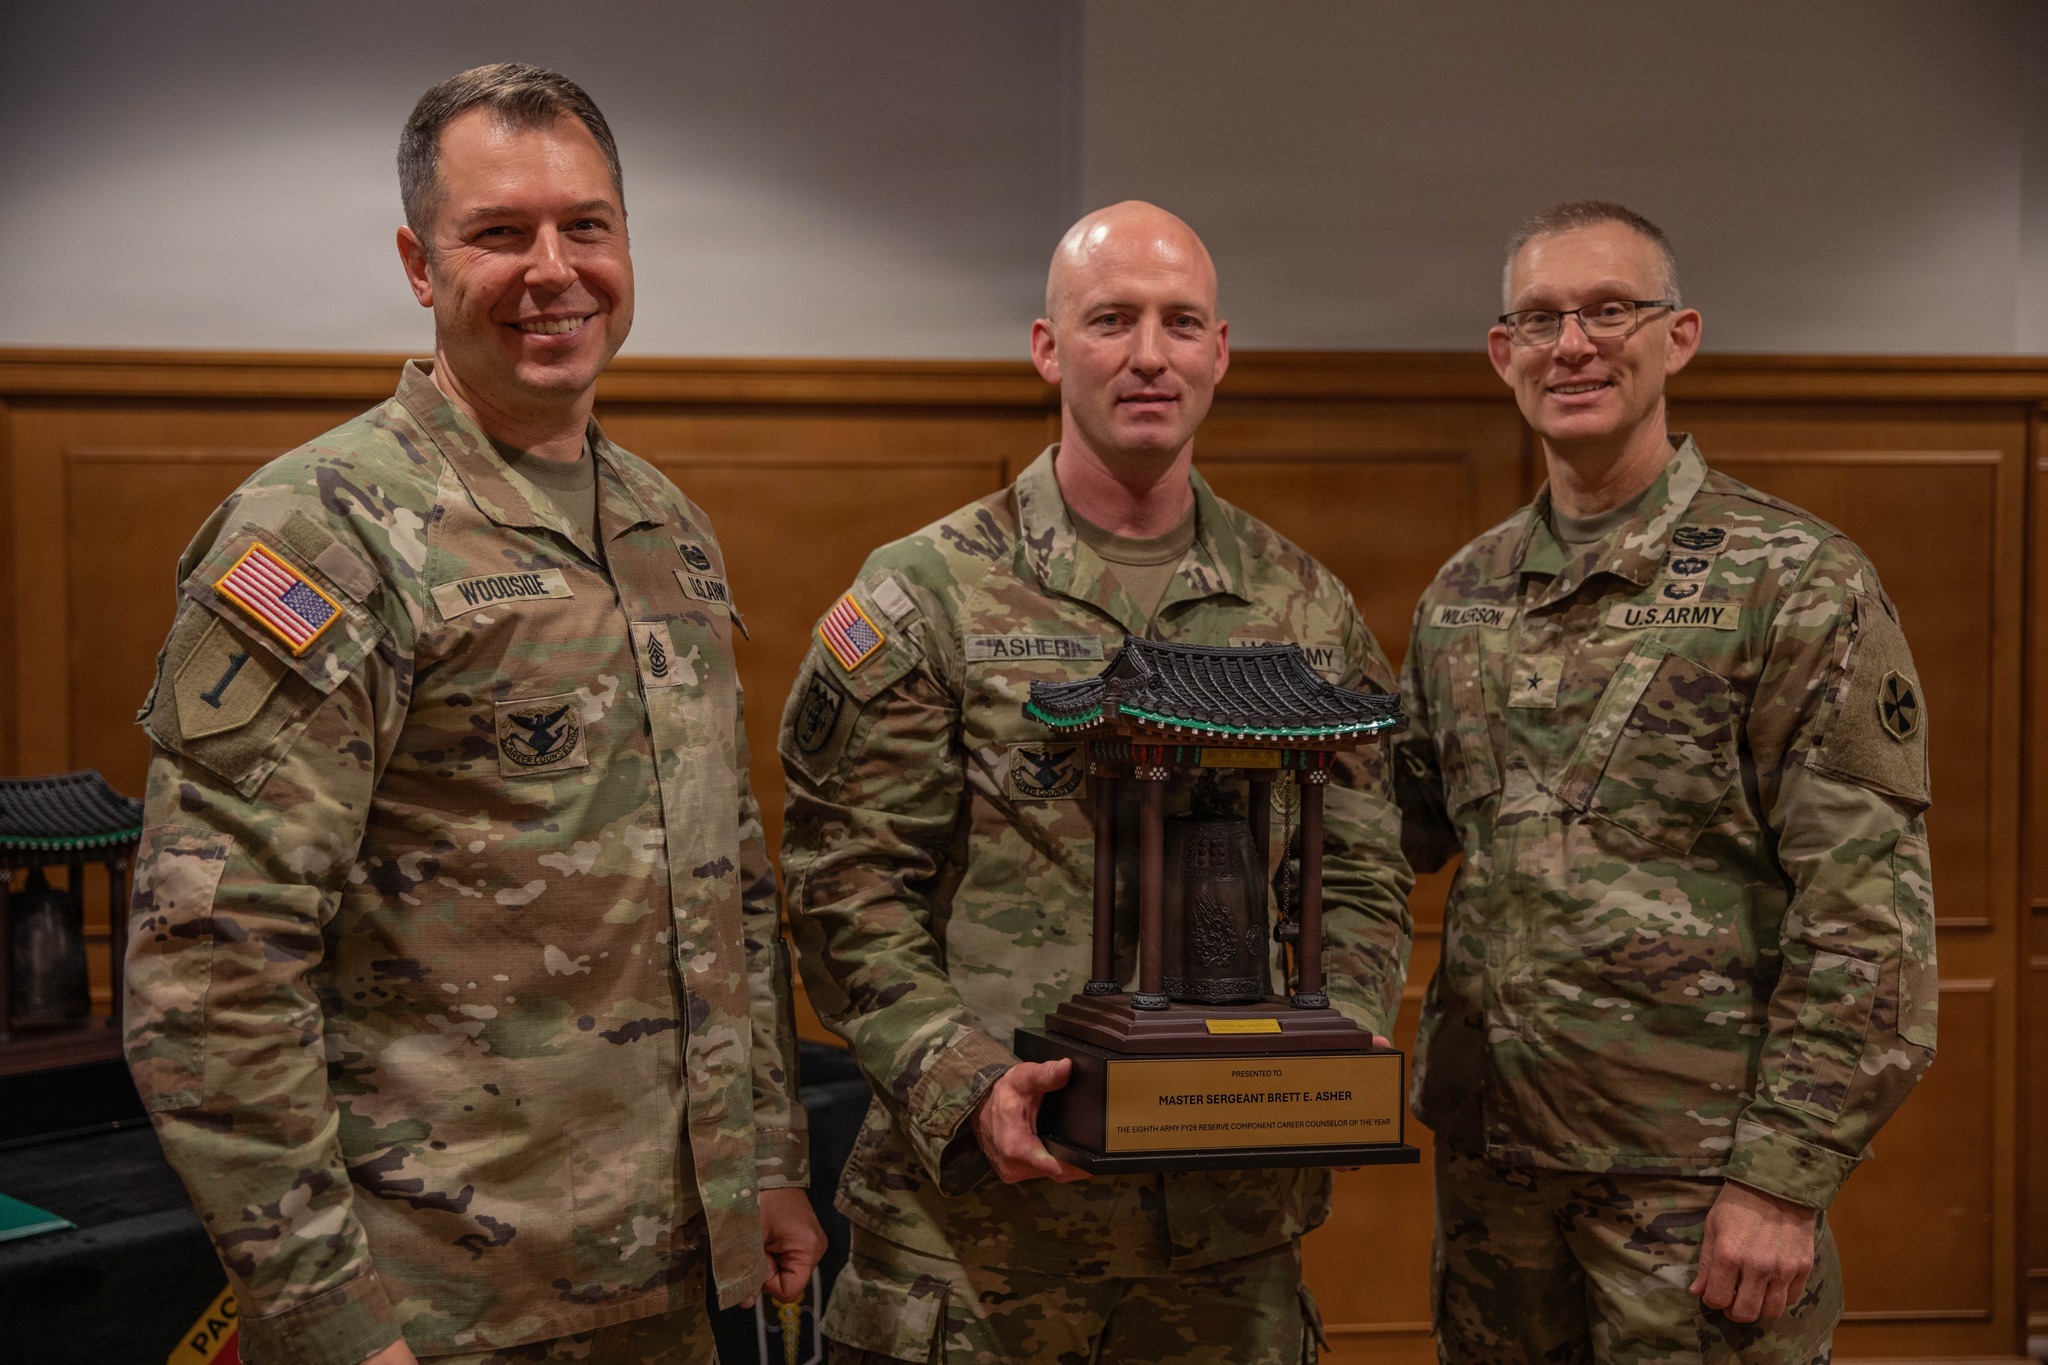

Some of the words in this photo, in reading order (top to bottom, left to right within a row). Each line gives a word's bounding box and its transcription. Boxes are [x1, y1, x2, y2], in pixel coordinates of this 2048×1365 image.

[456, 574, 550, 606] WOODSIDE
[1441, 607, 1505, 626] WILKERSON
[993, 638, 1070, 657] ASHER
[200, 651, 252, 709] 1
[505, 740, 532, 764] CAREER
[534, 730, 578, 765] COUNSELOR
[1231, 1070, 1272, 1078] PRESENTED
[1159, 1095, 1204, 1105] MASTER
[1206, 1093, 1265, 1104] SERGEANT
[1267, 1092, 1301, 1102] BRETT
[1303, 1092, 1313, 1102] E.
[1315, 1091, 1352, 1101] ASHER
[1132, 1125, 1159, 1133] EIGHTH
[1199, 1123, 1230, 1131] RESERVE
[1231, 1122, 1276, 1130] COMPONENT
[1277, 1121, 1304, 1129] CAREER
[1305, 1120, 1348, 1128] COUNSELOR
[1349, 1119, 1358, 1127] OF
[1373, 1118, 1391, 1126] YEAR
